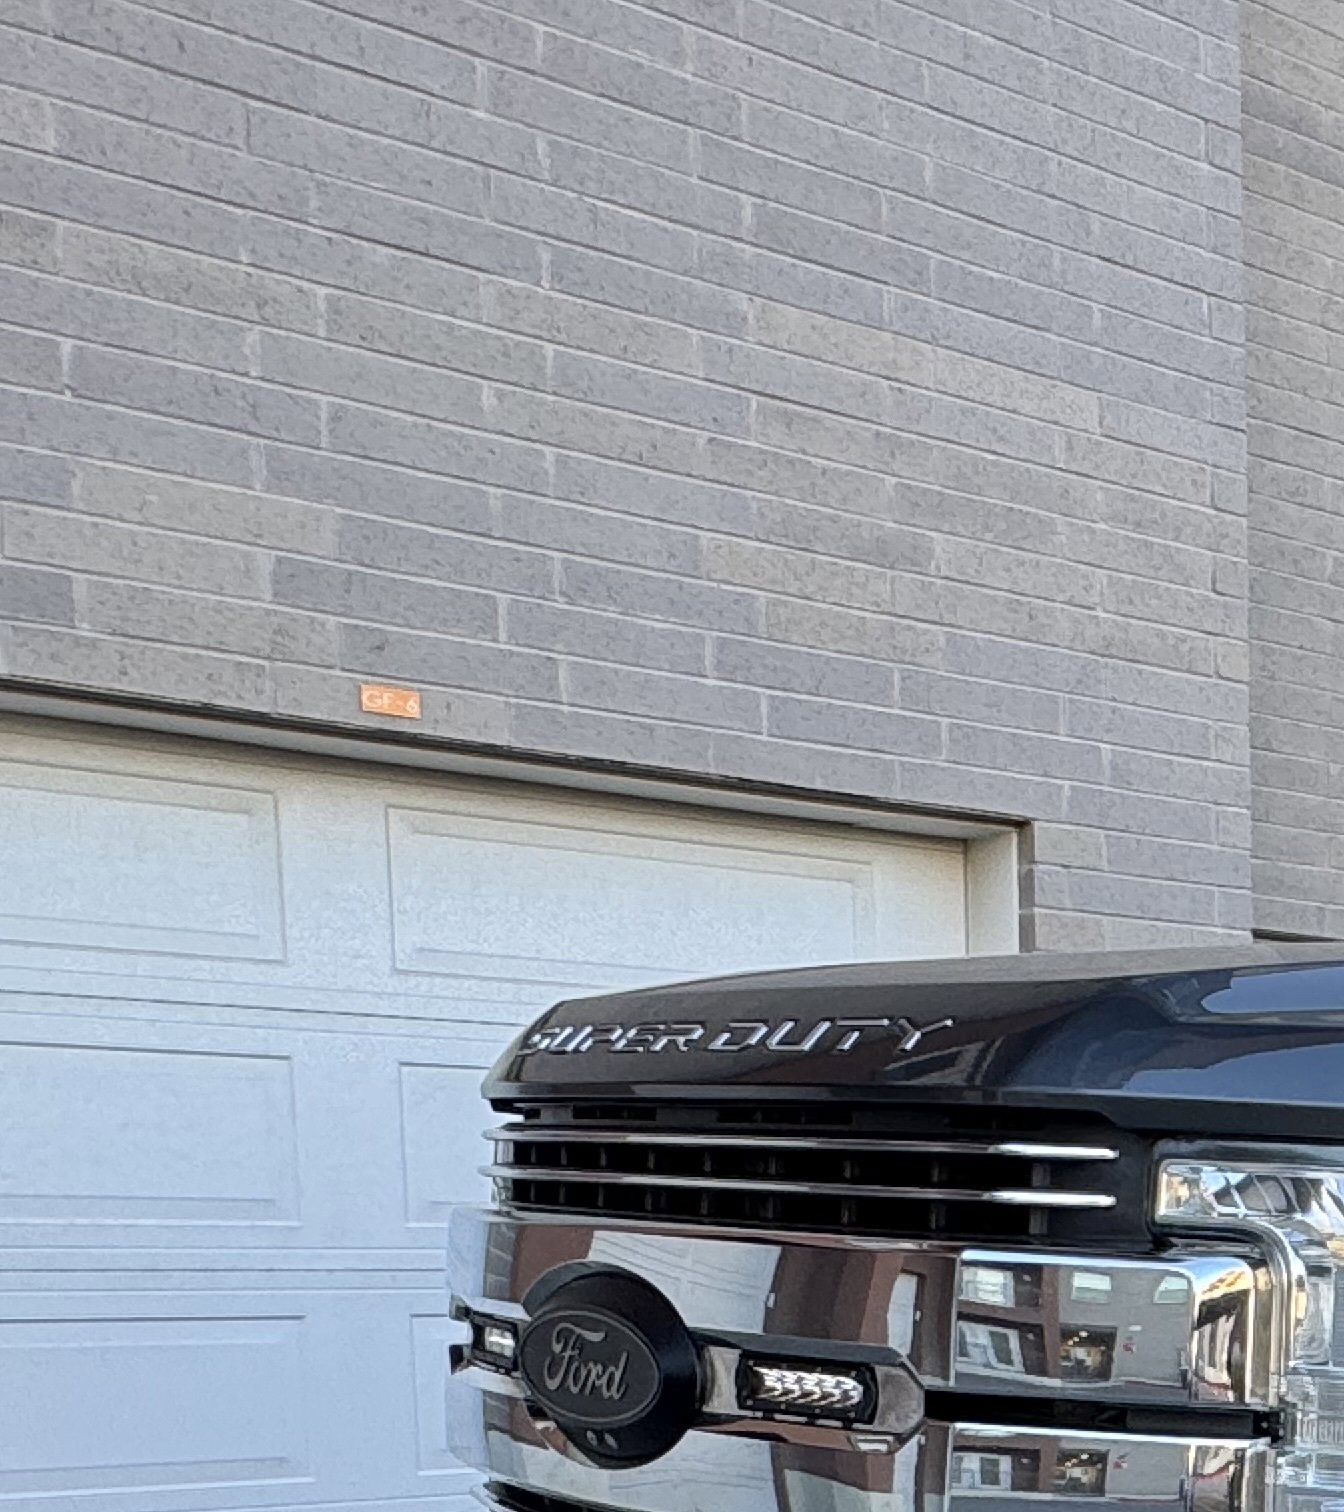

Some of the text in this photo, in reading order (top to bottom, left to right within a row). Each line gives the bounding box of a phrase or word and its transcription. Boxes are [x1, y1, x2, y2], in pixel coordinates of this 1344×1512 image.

[515, 1017, 954, 1056] SUPER DUTY
[544, 1321, 630, 1401] Ford
